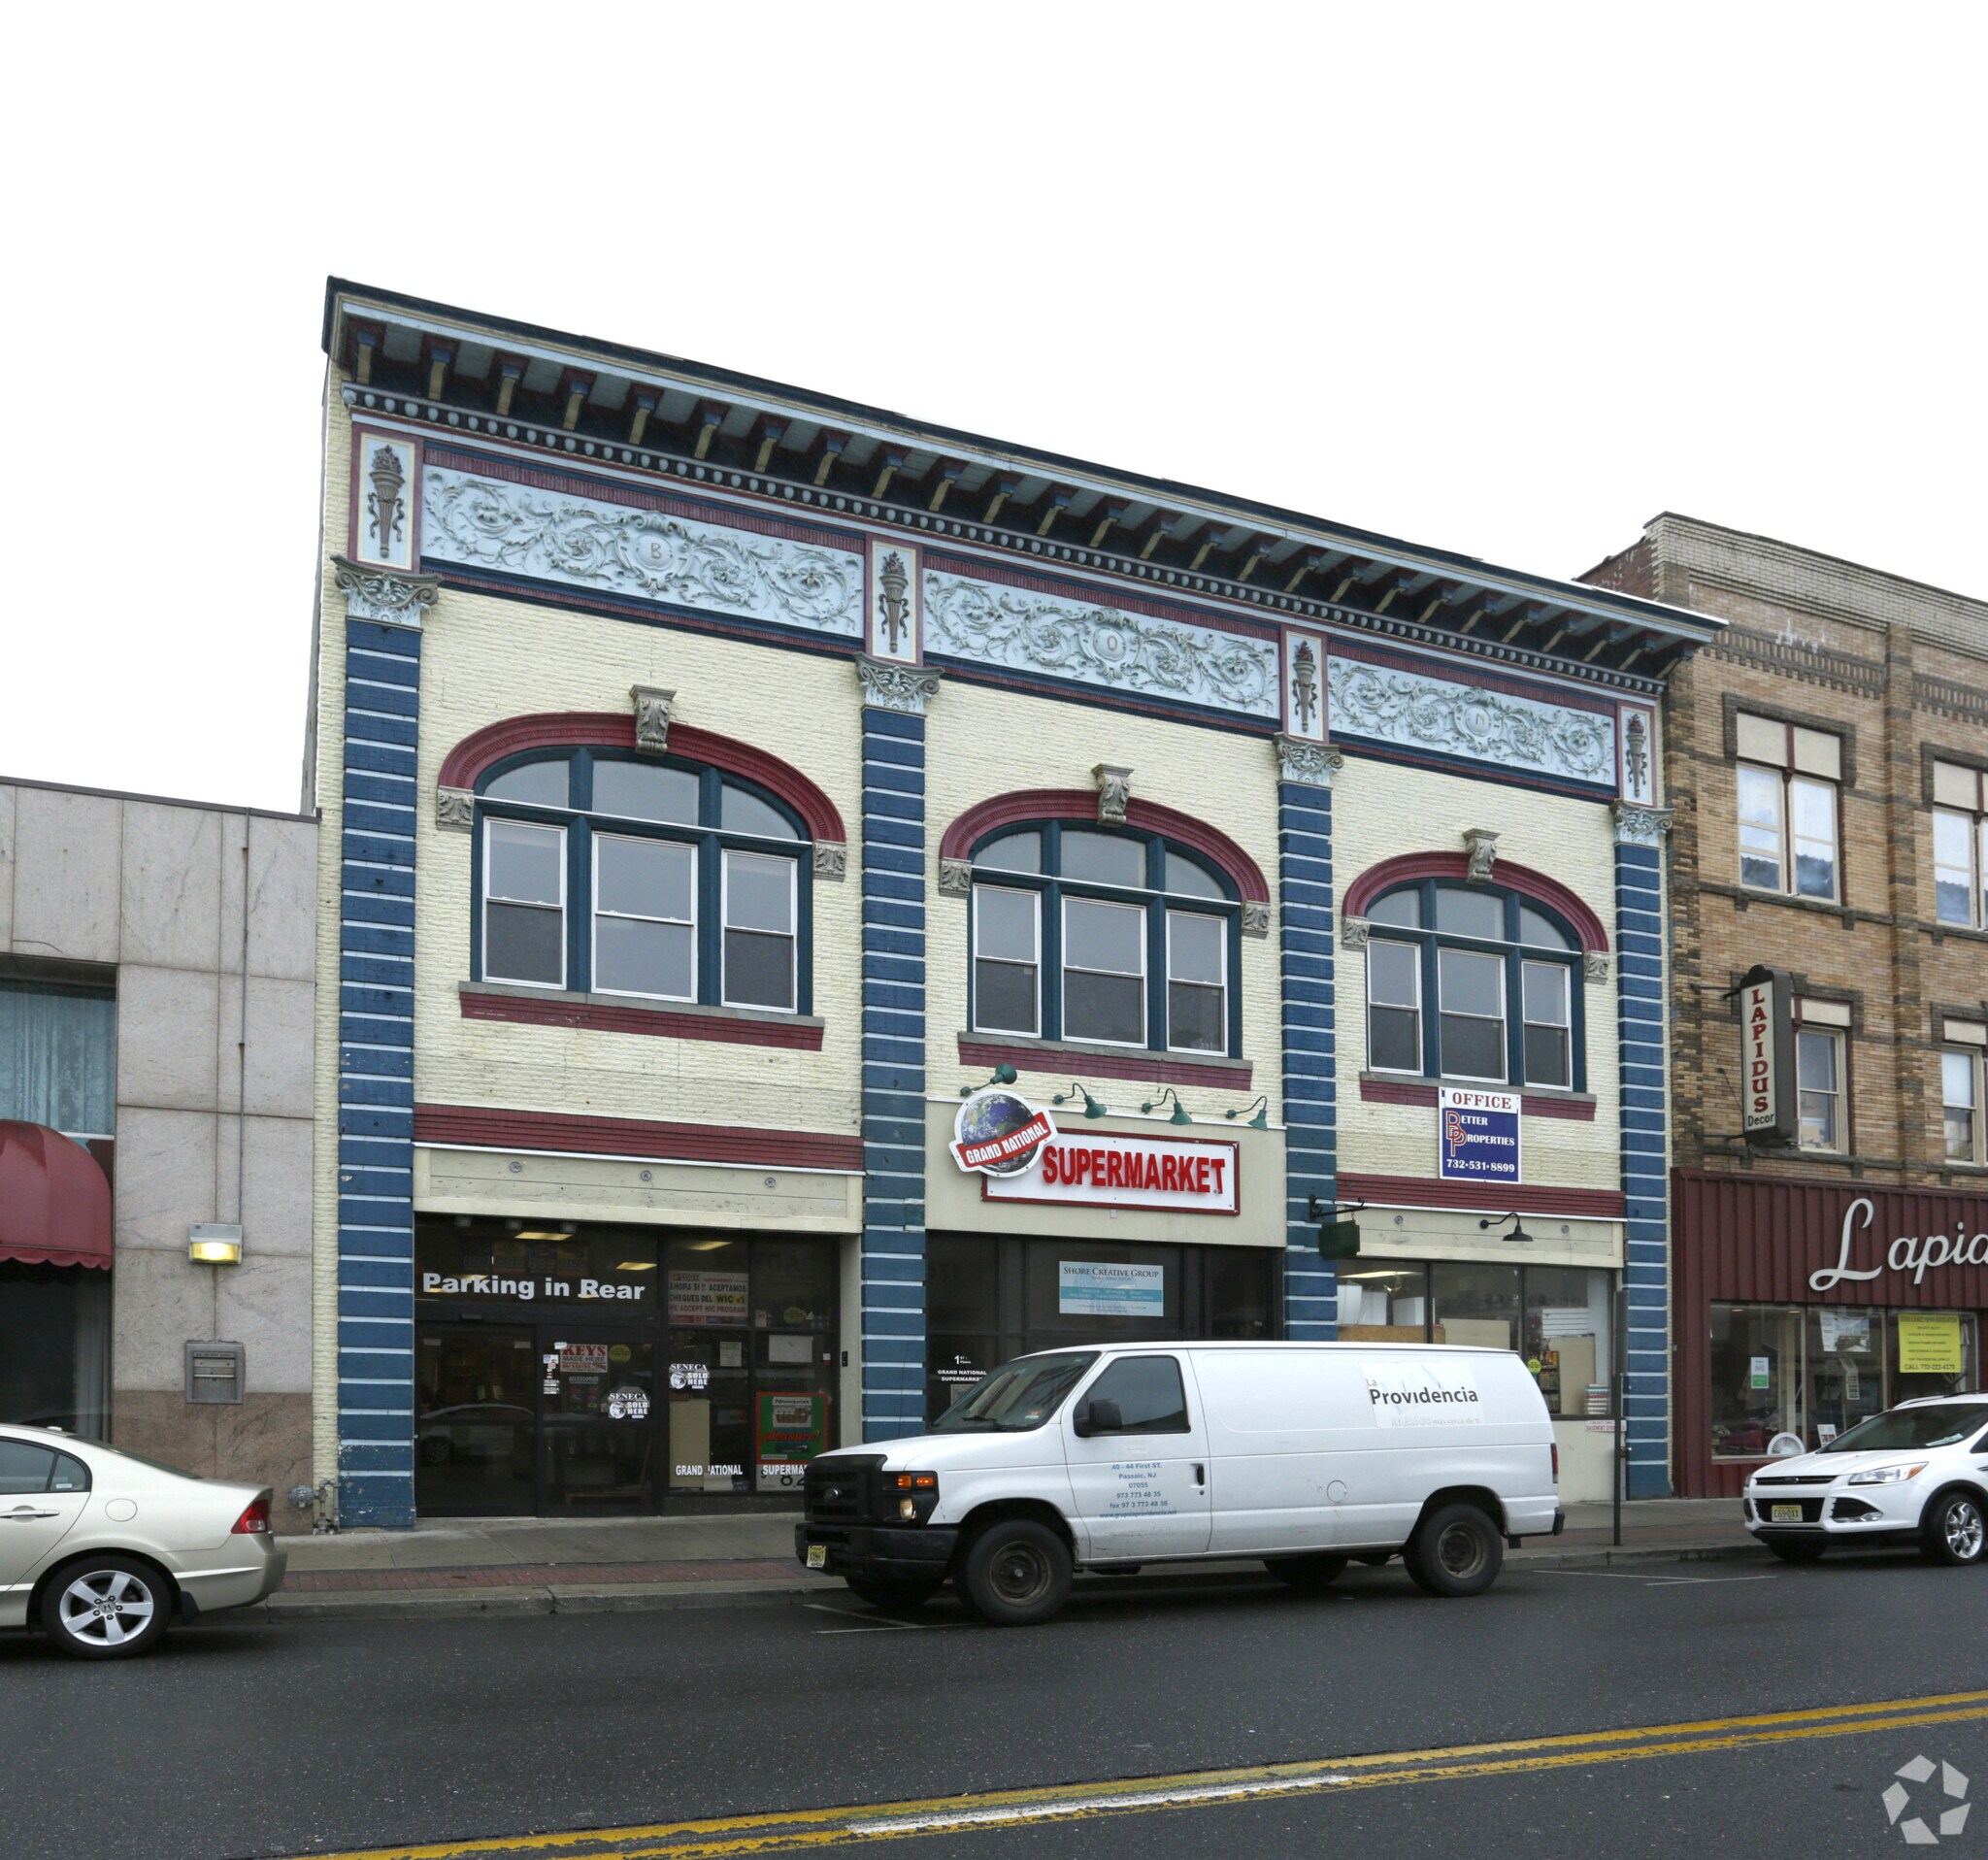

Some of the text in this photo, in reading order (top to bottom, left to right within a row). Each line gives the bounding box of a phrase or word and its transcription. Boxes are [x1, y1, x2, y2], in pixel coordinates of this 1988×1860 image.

[1750, 988, 1769, 1113] LAPIDUS
[1452, 1092, 1511, 1109] OFFICE
[1747, 1113, 1775, 1127] Decor
[966, 1120, 1048, 1166] GRAND NATIONAL
[1043, 1146, 1225, 1194] SUPERMARKET
[1064, 1266, 1159, 1278] SHORE CREATIVE GROUP
[423, 1273, 646, 1301] Parking in Rear
[669, 1294, 699, 1303] CHEQUES
[716, 1295, 734, 1304] WIC
[563, 1345, 607, 1357] KEYS
[1370, 1386, 1478, 1405] Providencia
[676, 1464, 743, 1476] GRAND ATIONAL
[763, 1465, 808, 1476] SUPERMA
